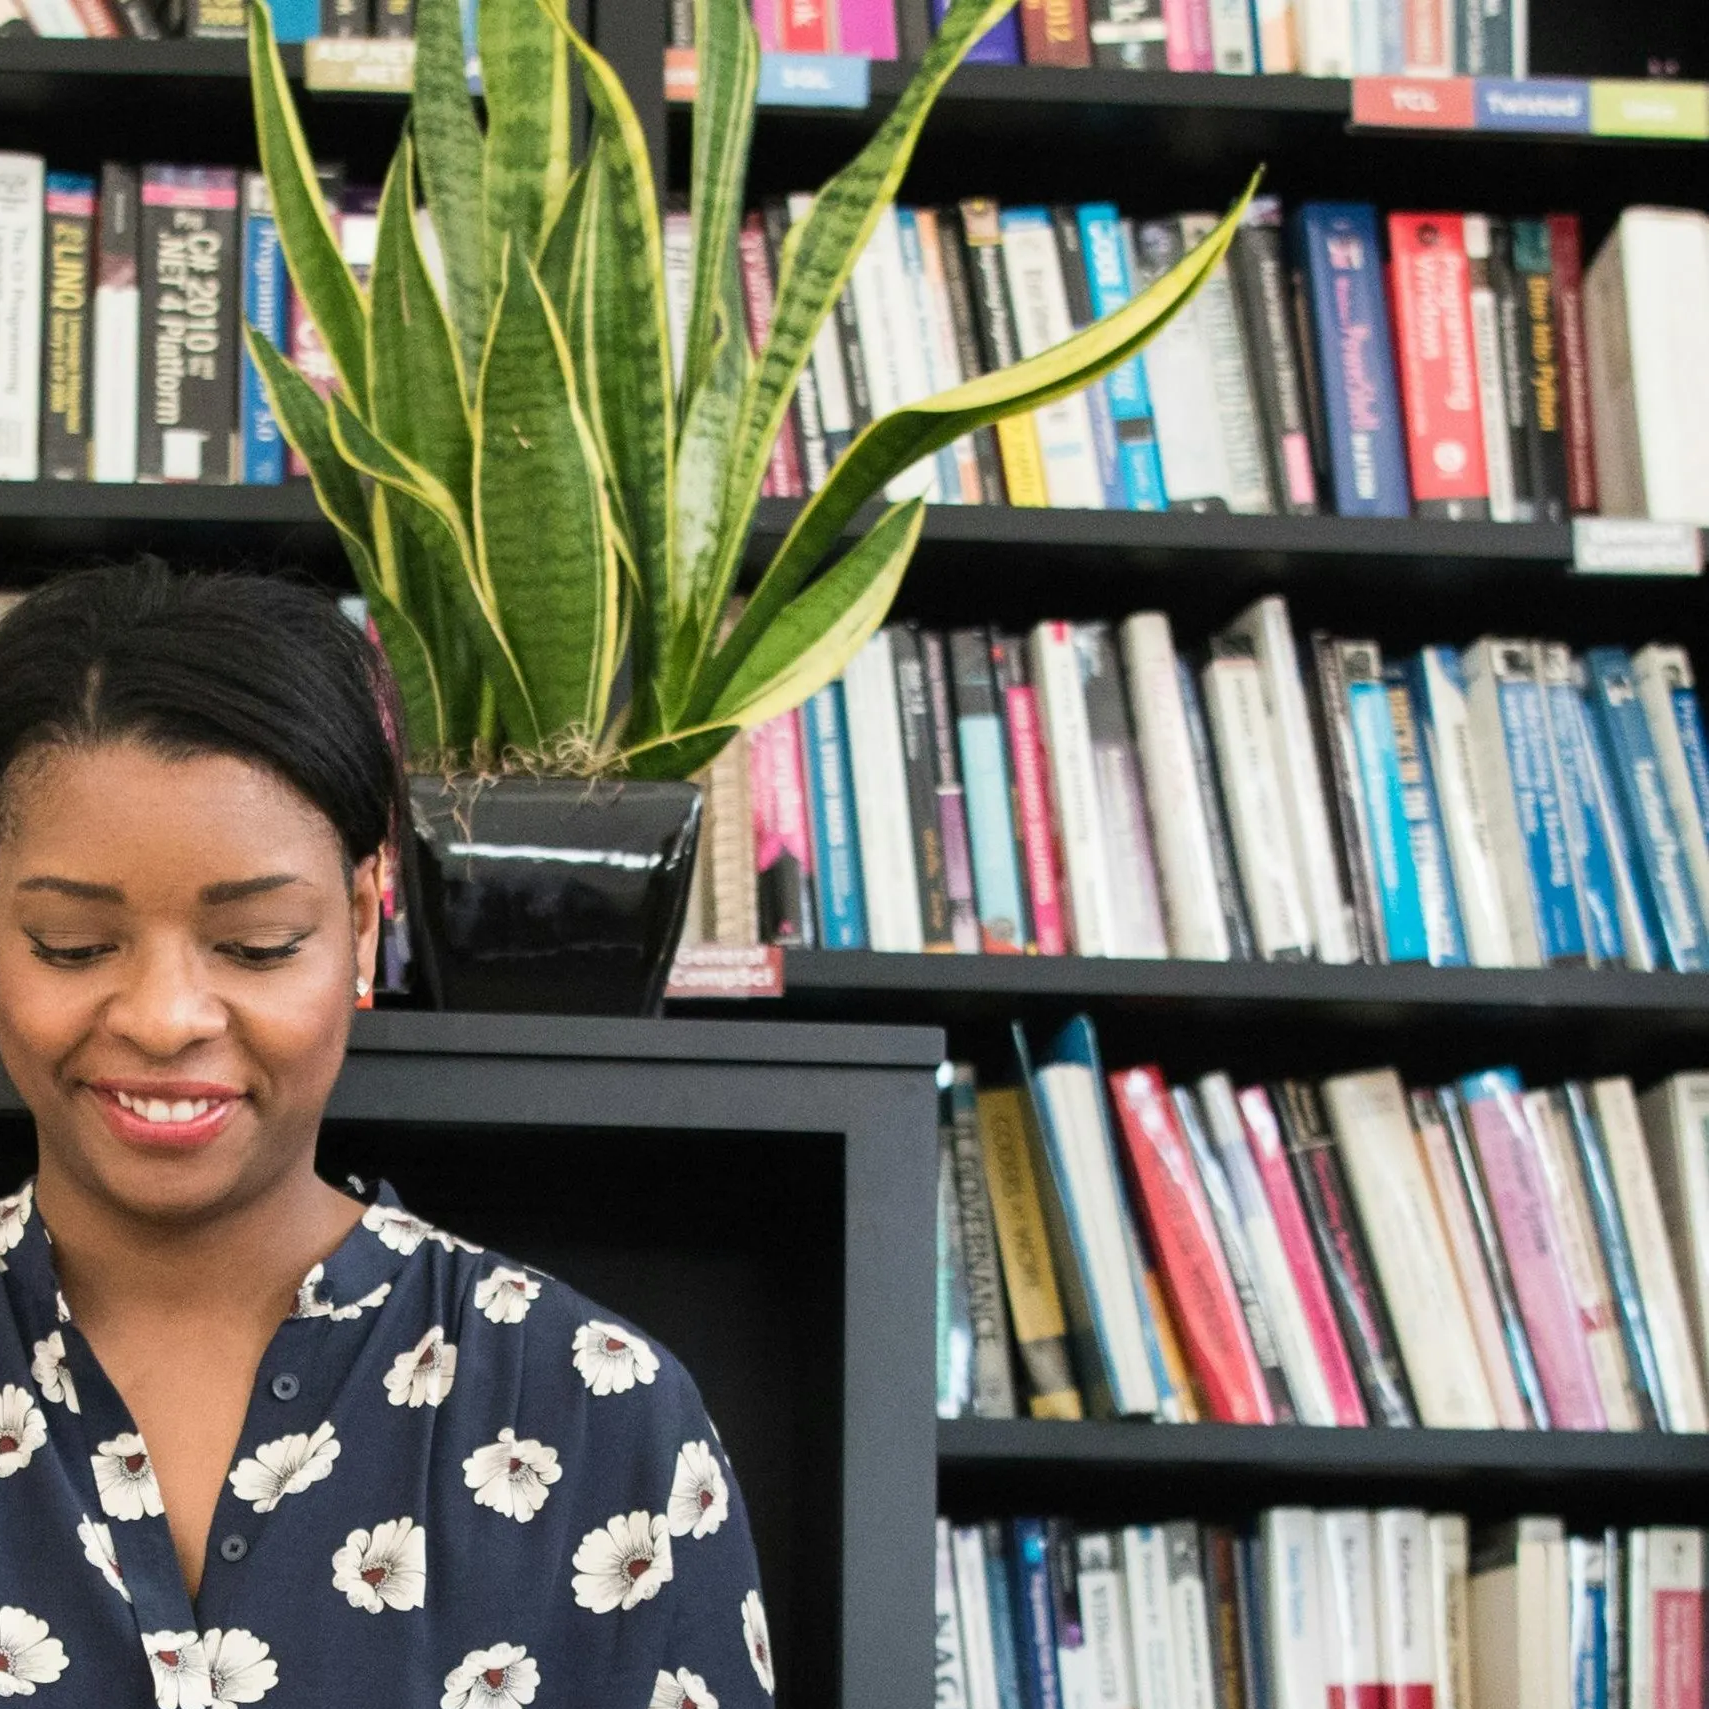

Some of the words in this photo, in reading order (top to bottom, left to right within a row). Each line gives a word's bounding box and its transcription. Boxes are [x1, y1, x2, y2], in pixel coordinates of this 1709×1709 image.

[1485, 92, 1583, 118] Twisted
[48, 244, 87, 310] LINQ
[157, 232, 184, 287] .NET
[185, 231, 220, 274] C#
[186, 279, 220, 353] 2010
[1412, 253, 1444, 361] Windows
[1431, 251, 1476, 412] Programming
[155, 318, 183, 425] Platform
[1530, 364, 1558, 432] Python
